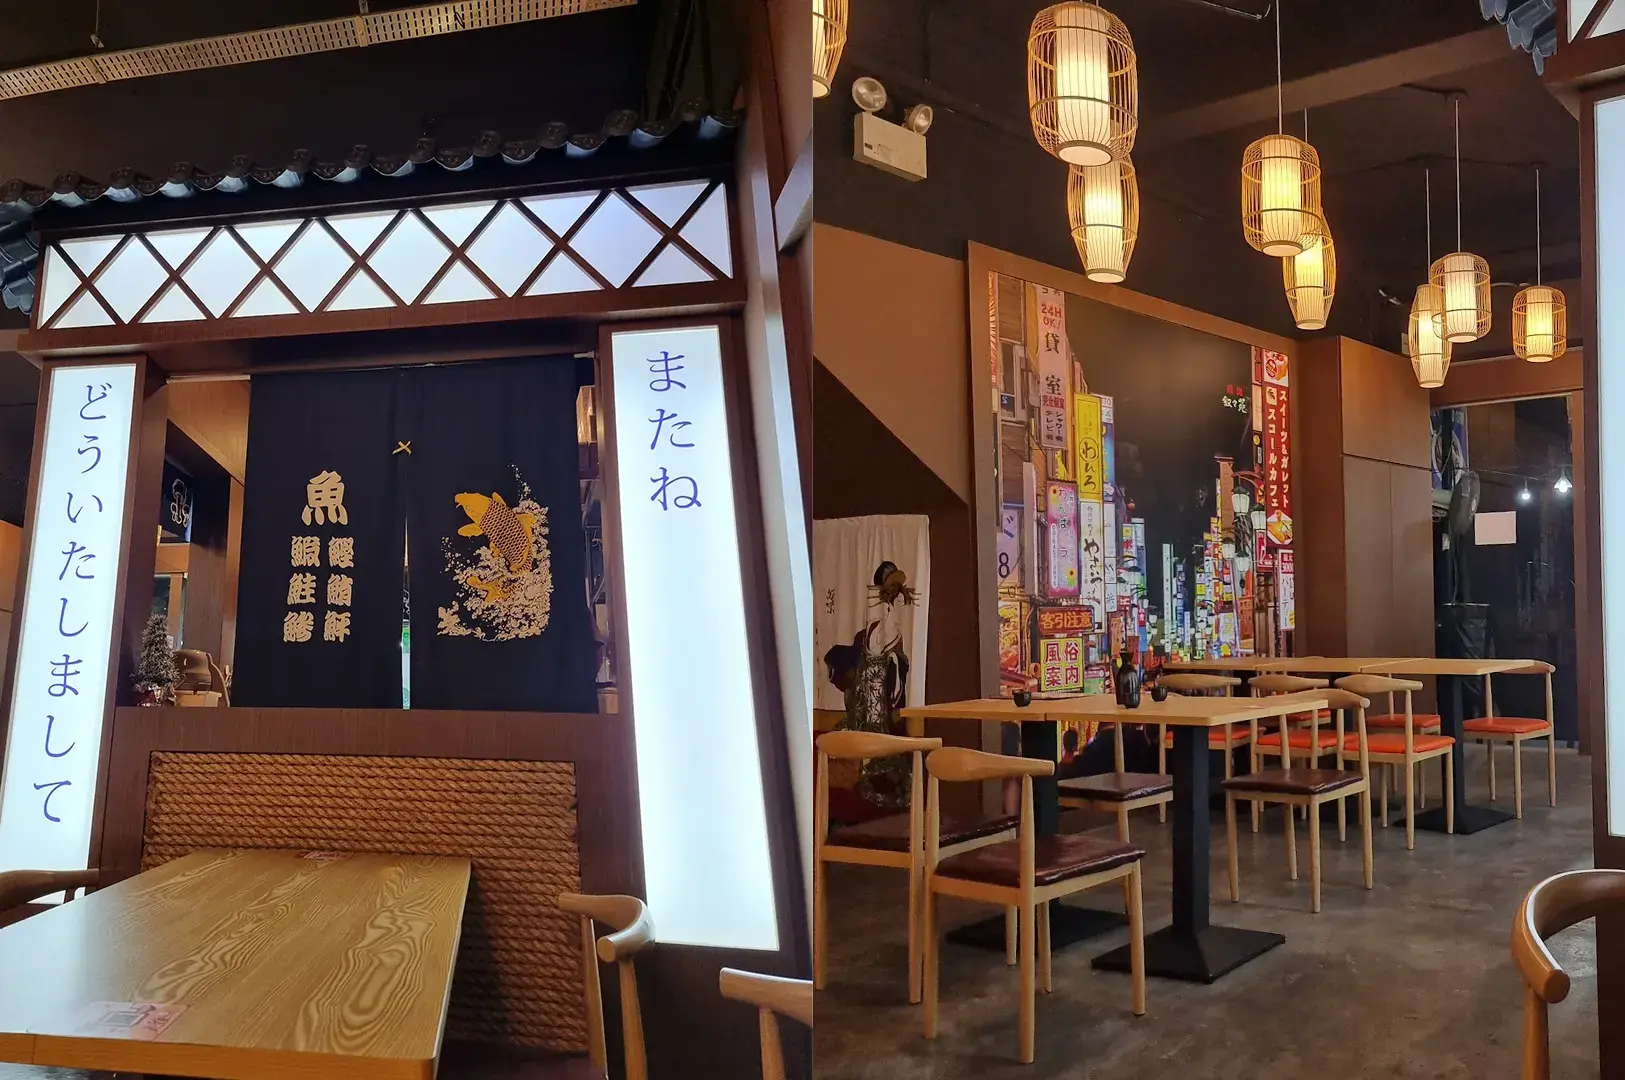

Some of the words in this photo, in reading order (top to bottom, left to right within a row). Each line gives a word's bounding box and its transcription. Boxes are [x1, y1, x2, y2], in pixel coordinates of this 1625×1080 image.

[1041, 303, 1062, 318] 24H
[645, 351, 702, 511] またね
[301, 469, 349, 526] 魚
[33, 382, 113, 823] どういたしまして
[1040, 611, 1092, 629] 客引注意
[1045, 642, 1079, 663] 風俗
[1046, 665, 1079, 686] 案内
